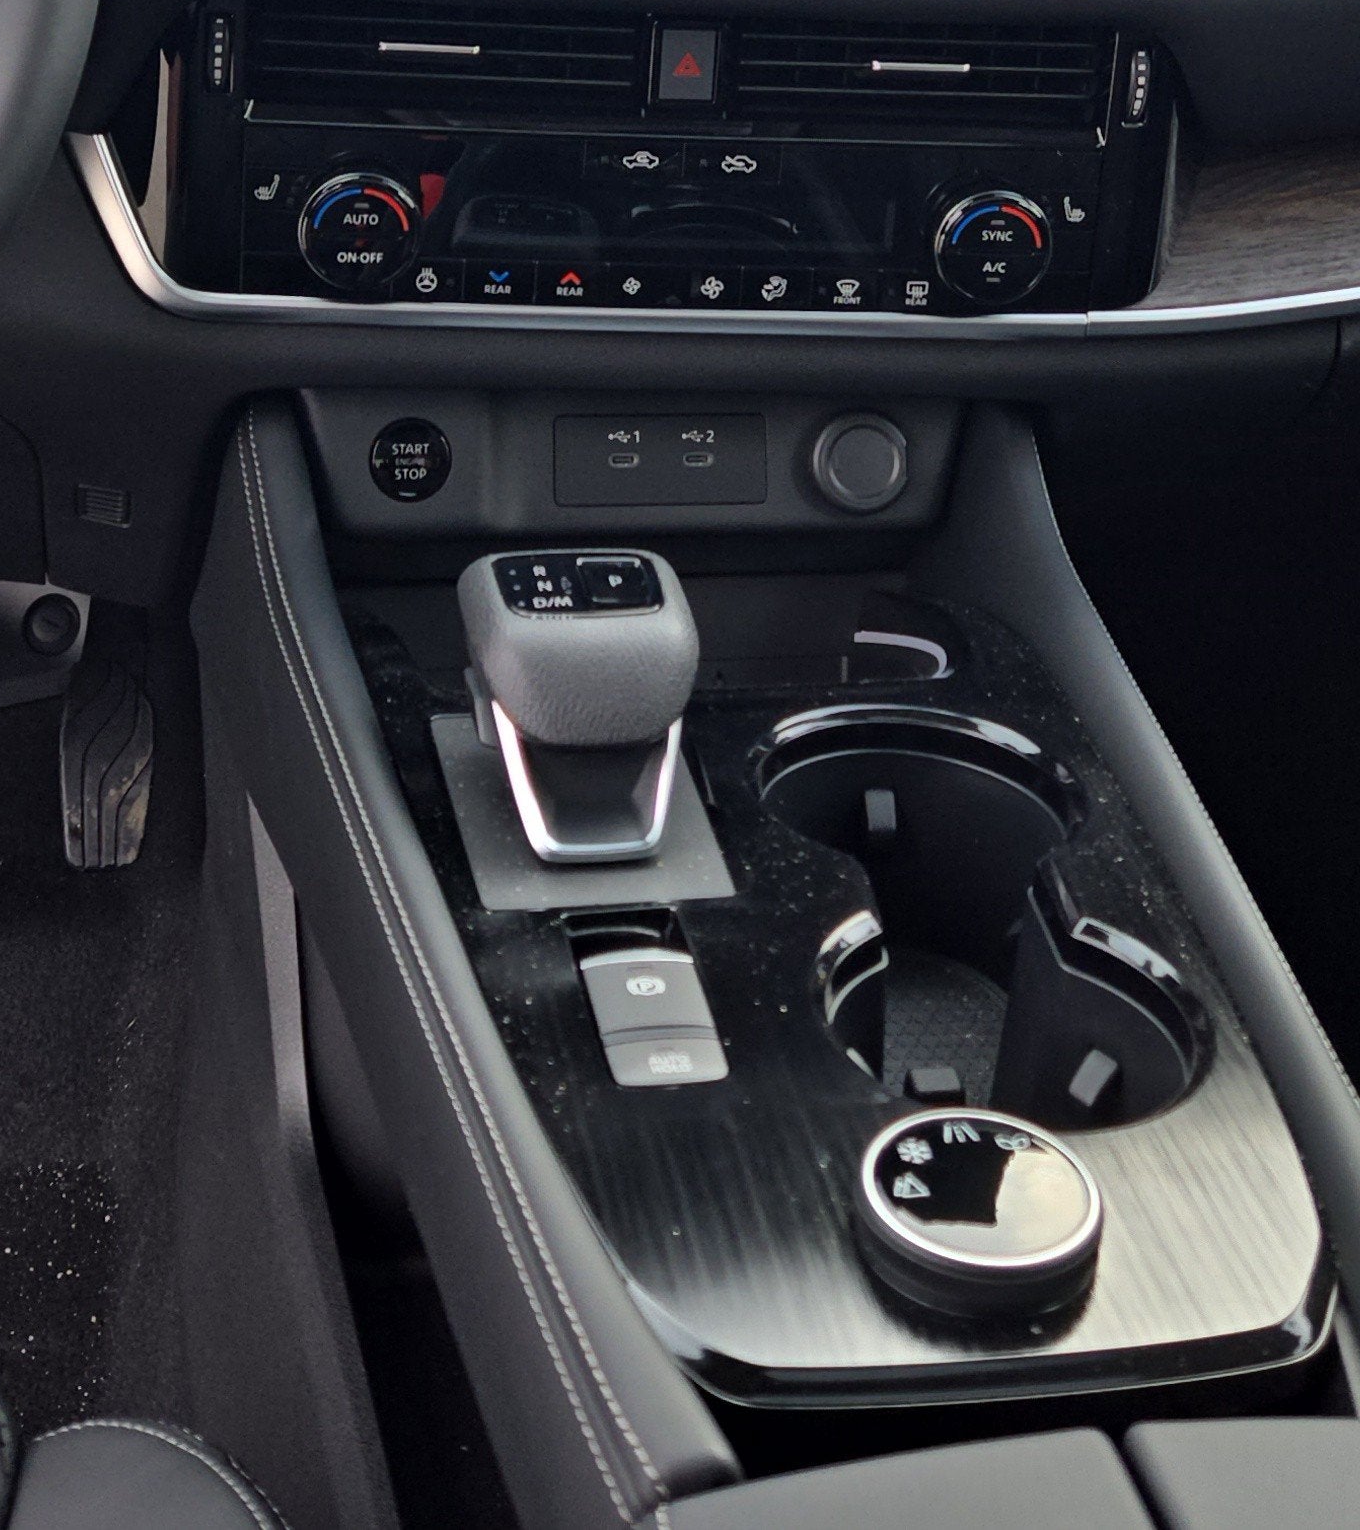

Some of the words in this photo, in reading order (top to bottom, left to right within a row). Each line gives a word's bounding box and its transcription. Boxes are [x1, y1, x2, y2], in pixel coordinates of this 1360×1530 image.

[342, 213, 379, 226] AUTO
[981, 229, 1014, 243] SYNC
[982, 260, 1007, 274] A/C
[483, 284, 511, 295] REAR
[555, 286, 583, 297] REAR
[833, 295, 861, 305] FRONT
[632, 429, 641, 444] 1
[705, 429, 715, 444] 2
[391, 442, 429, 456] START
[395, 467, 427, 481] STOP
[536, 580, 553, 592] N
[532, 595, 574, 609] D/M
